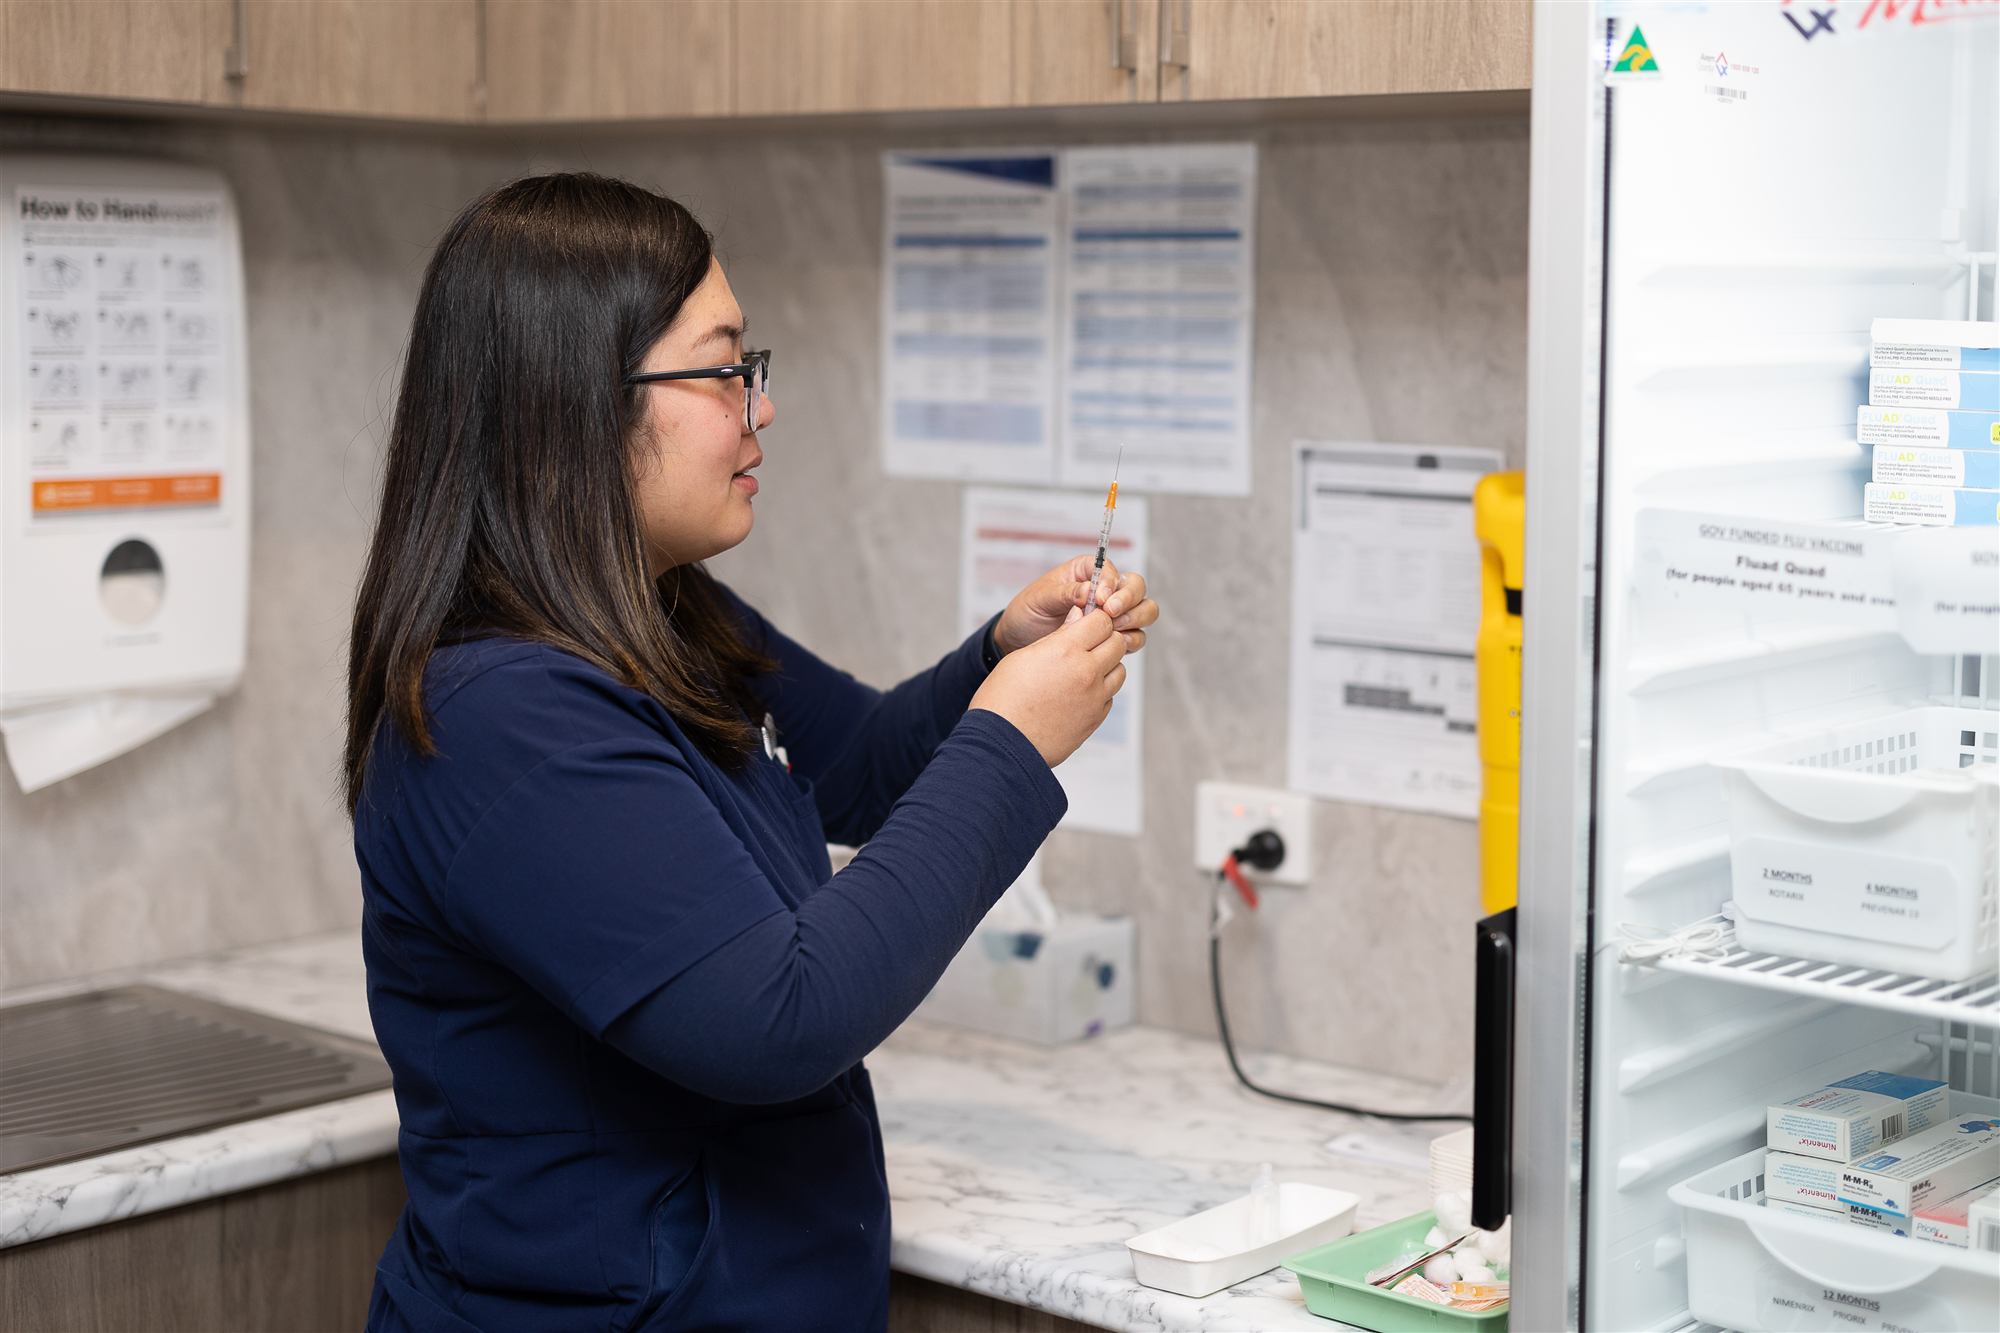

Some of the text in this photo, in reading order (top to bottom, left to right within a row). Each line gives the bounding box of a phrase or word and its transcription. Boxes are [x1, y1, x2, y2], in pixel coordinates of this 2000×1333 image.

[21, 198, 69, 220] How
[76, 200, 98, 221] to
[1699, 524, 1864, 556] GOV FUNDED FLU VACCINE
[1736, 555, 1826, 578] Fluad Quad
[1666, 568, 1688, 581] (for
[1692, 572, 1736, 588] people
[1740, 578, 1773, 592] aged
[1777, 582, 1794, 595] 65
[1798, 586, 1835, 601] years
[1770, 868, 1813, 885] MONTHS
[1874, 883, 1919, 900] MONTHS
[1800, 1138, 1837, 1151] Nimenrix
[1799, 1187, 1836, 1201] Nimenrix
[1773, 1297, 1815, 1314] NIMENRIX
[1833, 1310, 1866, 1325] PRIORIX
[1822, 1289, 1880, 1311] 12 MONTHS
